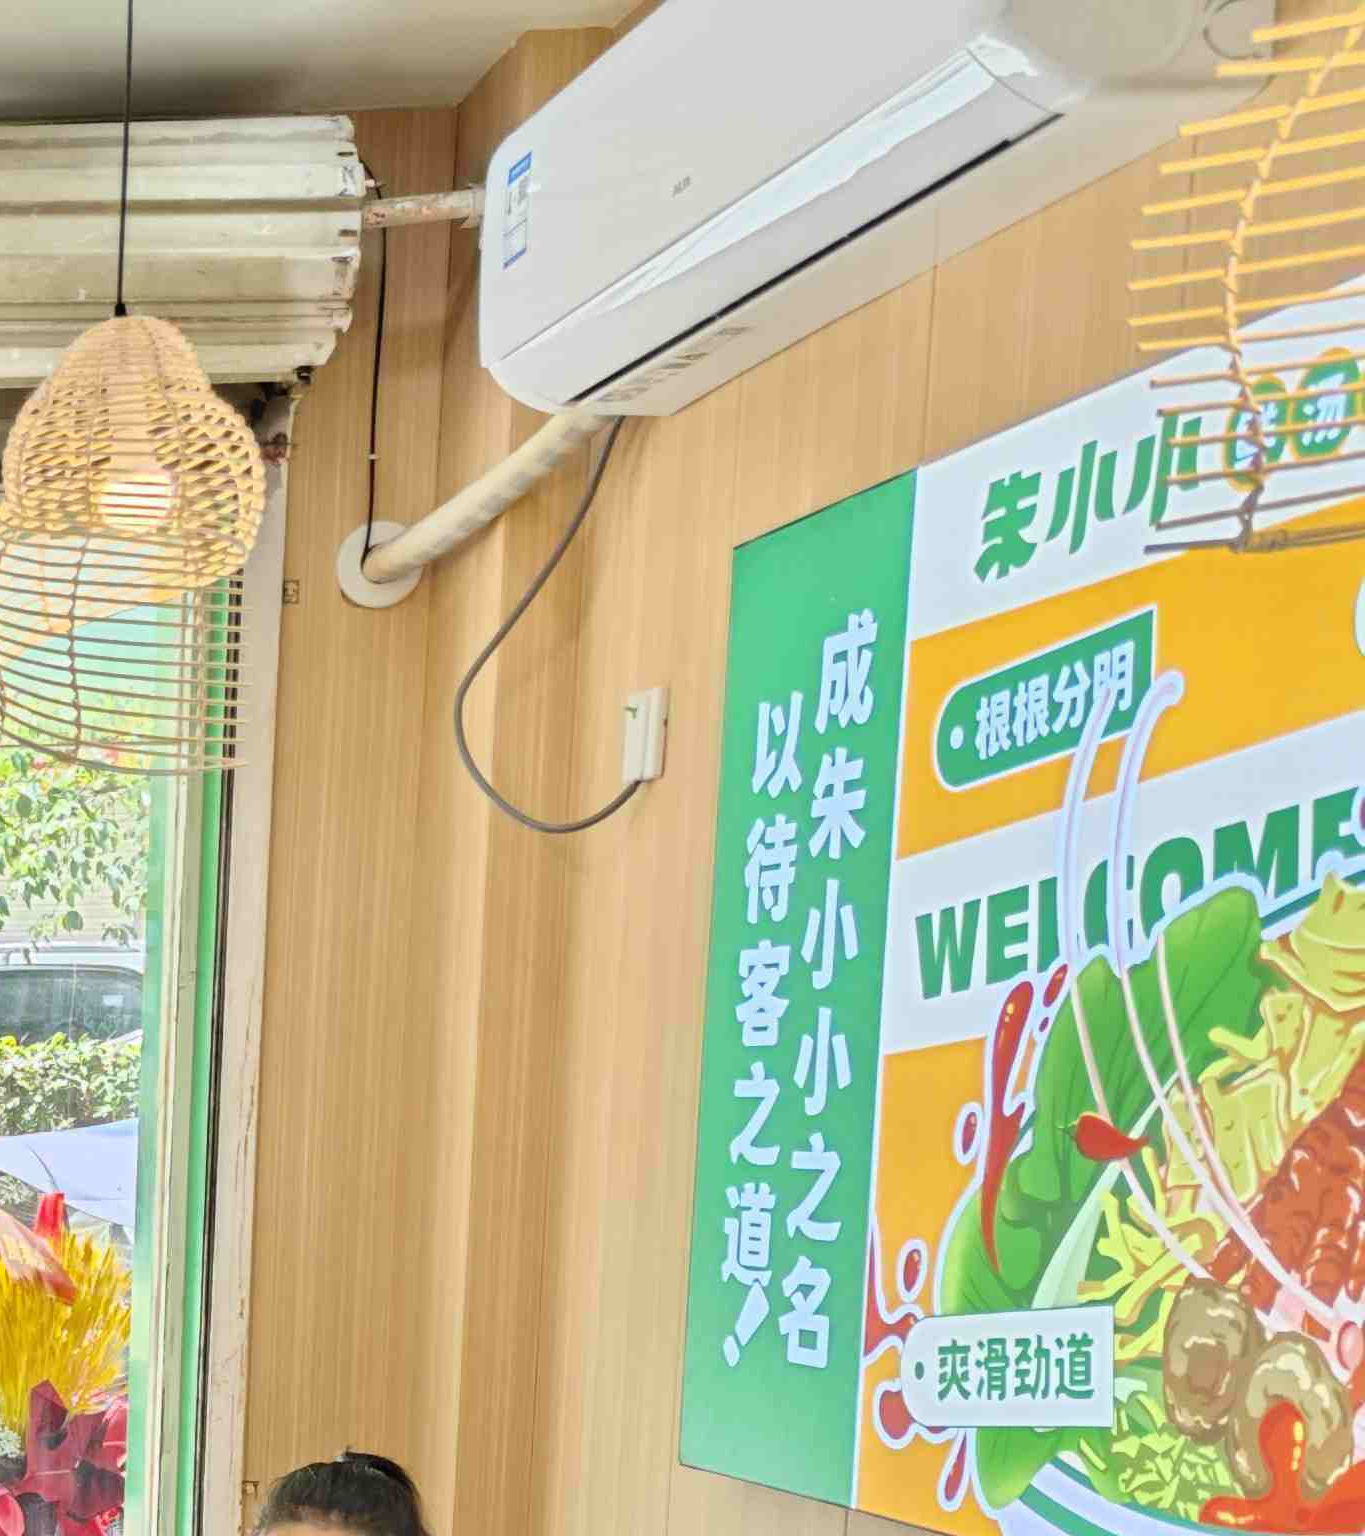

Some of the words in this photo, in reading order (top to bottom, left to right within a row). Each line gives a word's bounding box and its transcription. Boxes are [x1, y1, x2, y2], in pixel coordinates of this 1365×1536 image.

[973, 412, 1202, 583] 朱小小
[974, 640, 1136, 760] 根根分明
[778, 607, 878, 1368] 成朱小小之名
[936, 1332, 1095, 1402] 爽滑劲道
